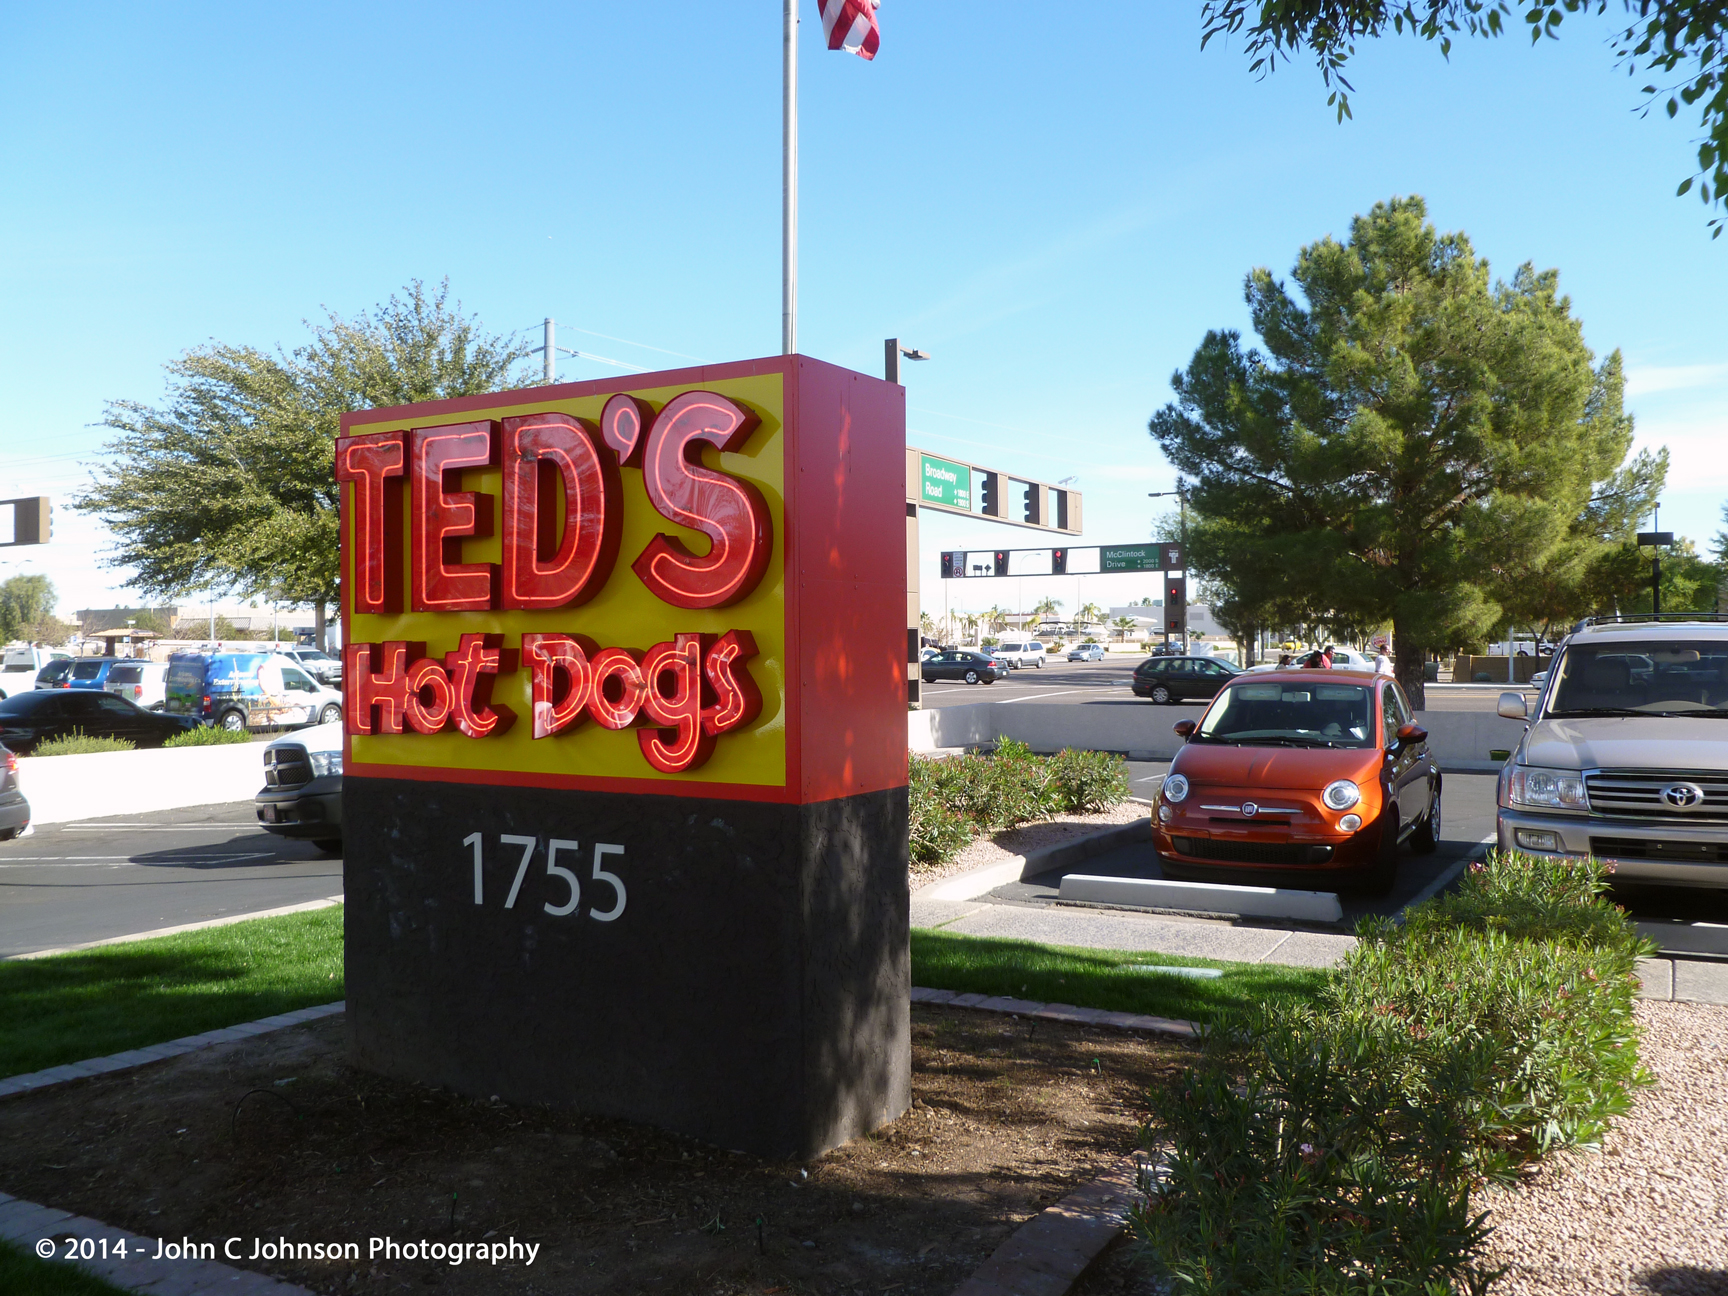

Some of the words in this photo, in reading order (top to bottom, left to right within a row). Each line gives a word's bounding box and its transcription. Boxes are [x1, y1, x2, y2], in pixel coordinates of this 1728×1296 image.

[335, 390, 773, 613] TED'S
[925, 463, 957, 485] Broadway
[925, 481, 943, 498] Road
[1106, 550, 1146, 558] McClintock
[346, 633, 517, 739] Hot
[521, 629, 762, 774] Dogs
[462, 831, 627, 922] 1755
